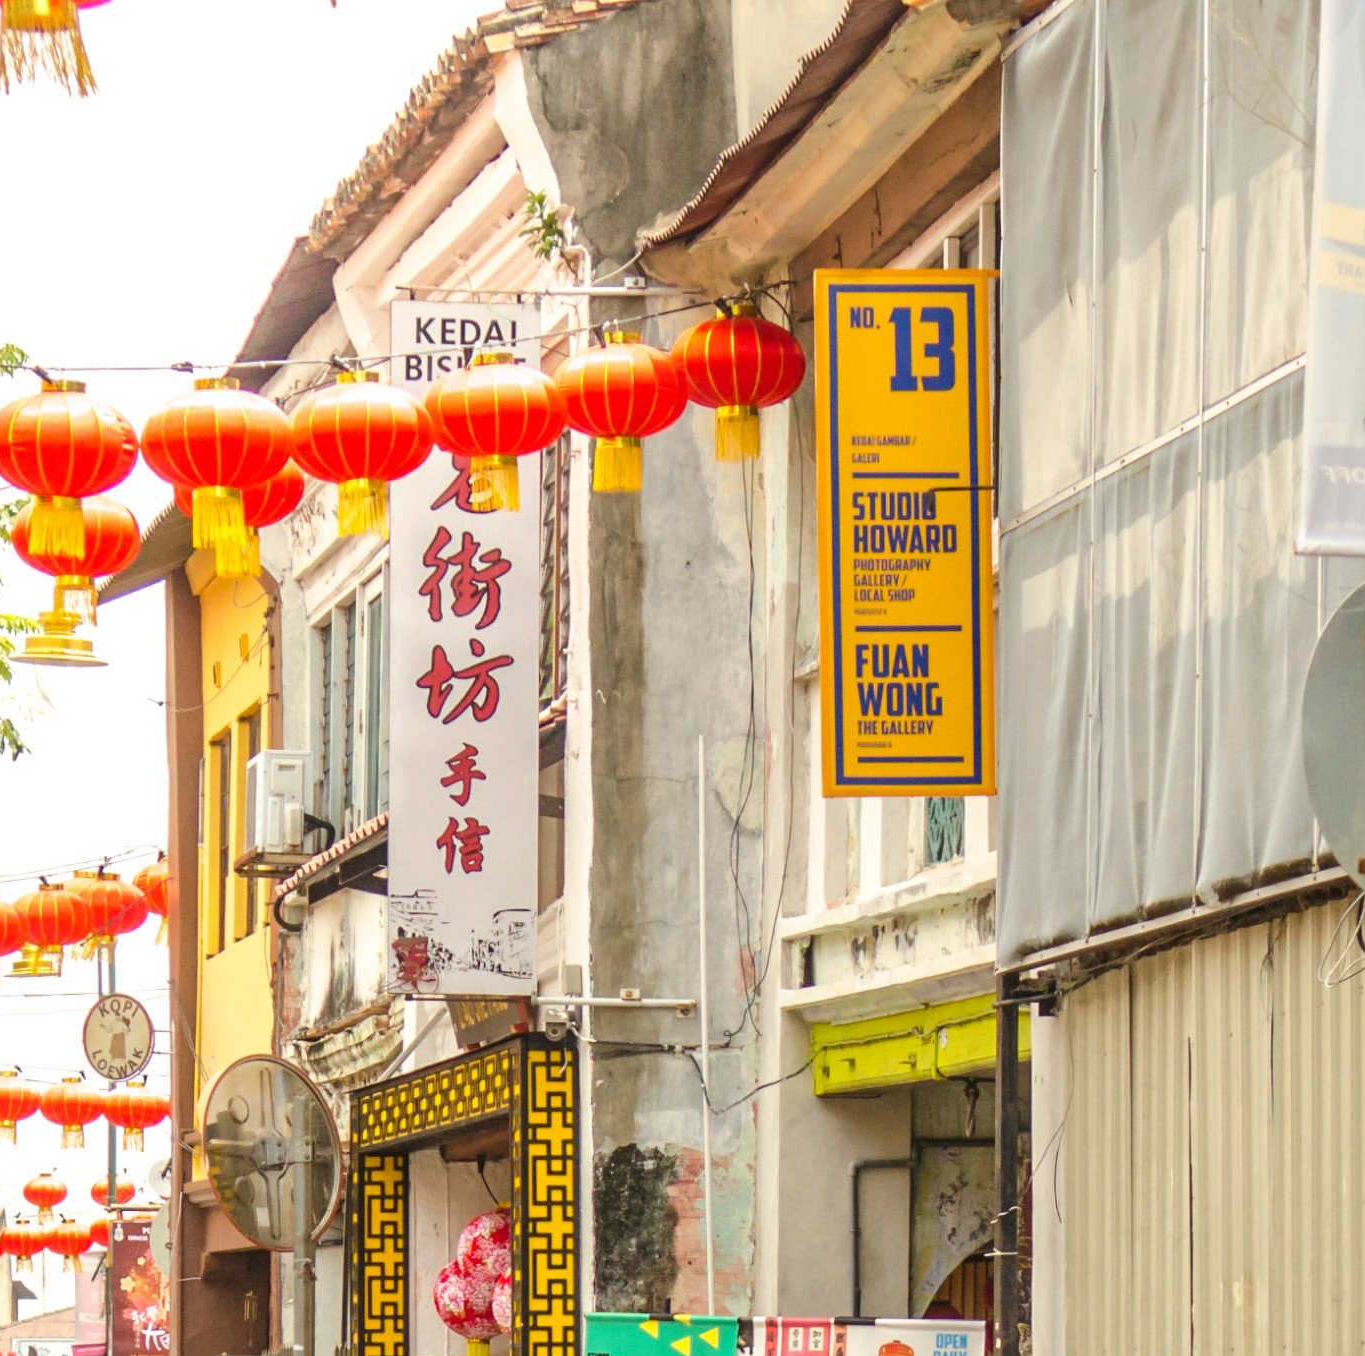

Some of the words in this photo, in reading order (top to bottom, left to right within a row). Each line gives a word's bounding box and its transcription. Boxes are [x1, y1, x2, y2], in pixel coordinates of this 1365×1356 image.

[850, 307, 880, 329] NO.
[415, 317, 517, 347] KEDAI
[888, 307, 955, 391] 13
[852, 491, 936, 521] STUDIO
[853, 524, 957, 553] HOWARD
[853, 558, 931, 571] PHOTOGRAPHY
[854, 574, 899, 586] GALLERY
[854, 589, 884, 602] LOCAL
[888, 588, 915, 602] SHOP
[855, 643, 929, 678] FUAN
[857, 682, 942, 716] WONG
[858, 720, 877, 735] THE
[881, 720, 933, 735] GALLERY
[98, 999, 139, 1018] KOPI
[92, 1047, 143, 1079] LOEWAK
[935, 1333, 968, 1349] OPEN
